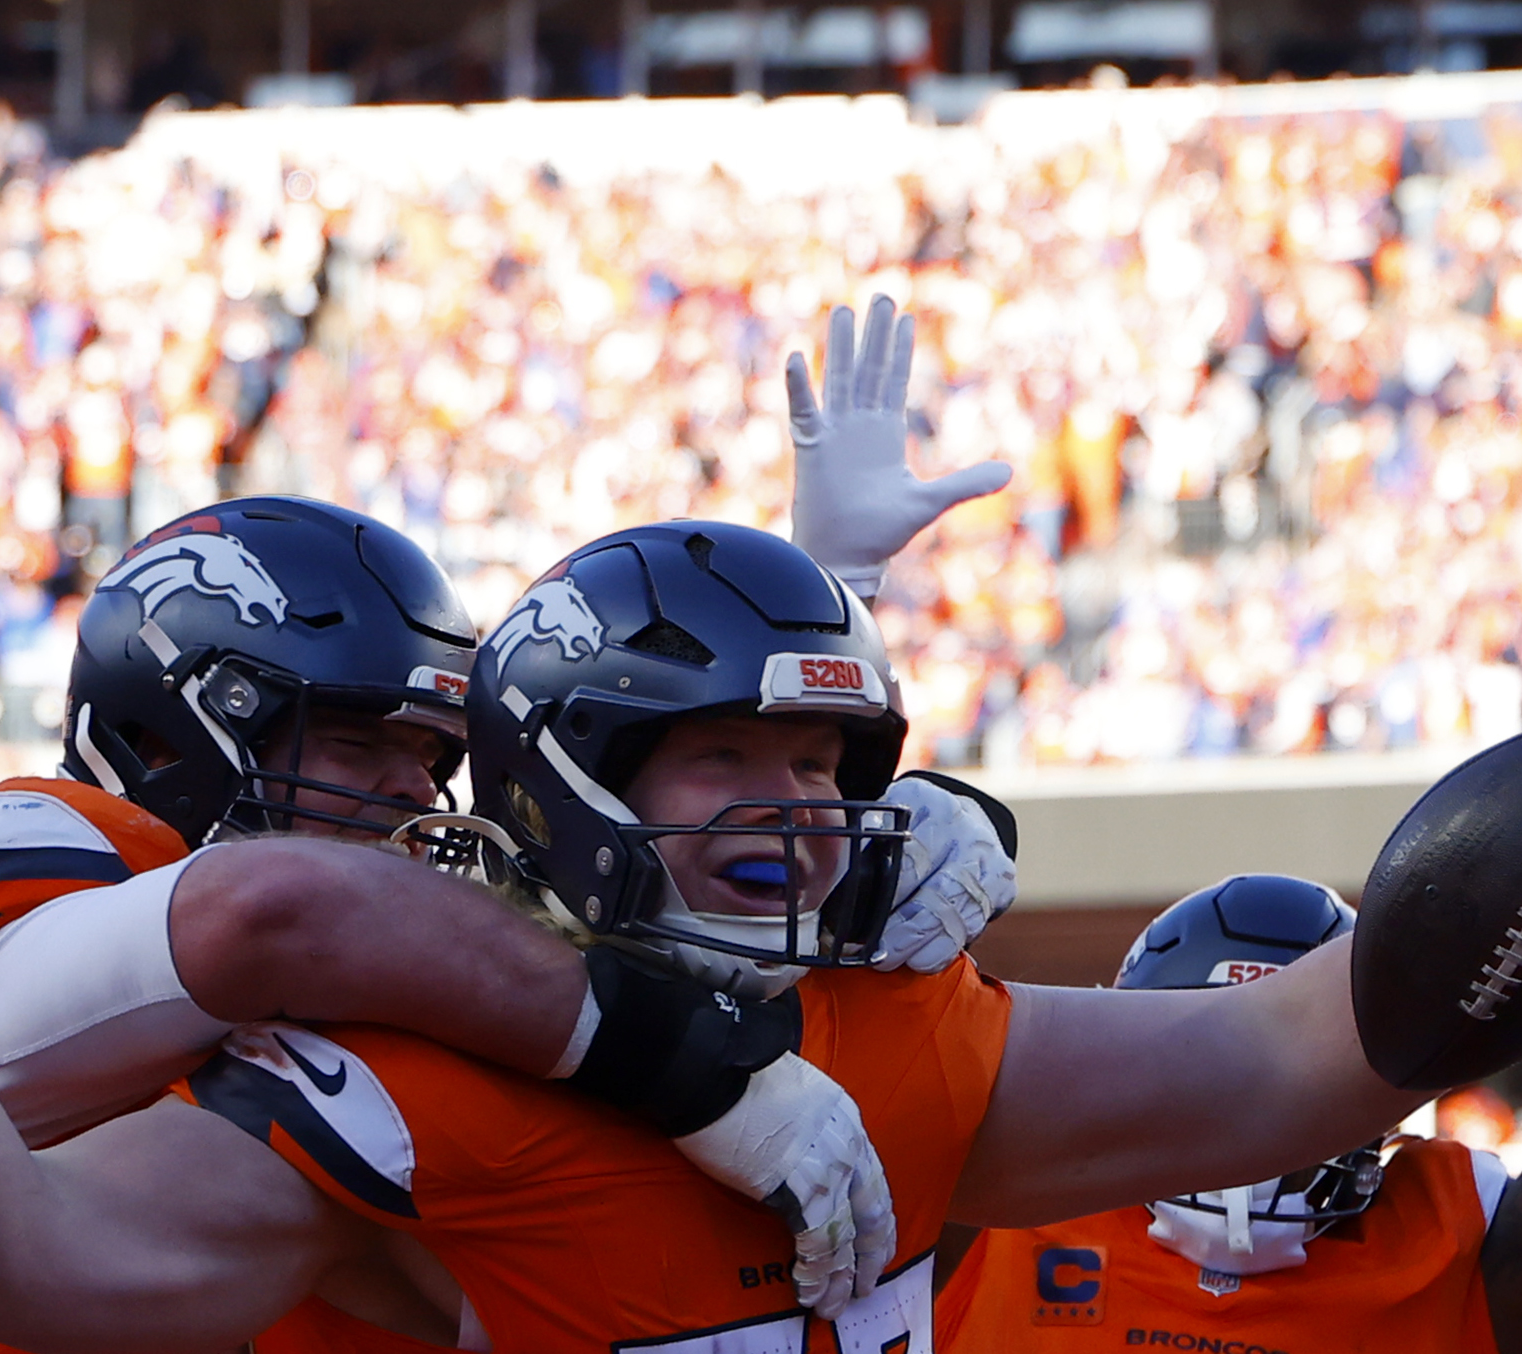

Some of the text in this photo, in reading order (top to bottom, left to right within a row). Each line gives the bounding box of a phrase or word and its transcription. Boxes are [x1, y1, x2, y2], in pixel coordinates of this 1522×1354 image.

[800, 659, 864, 690] 5280
[1227, 963, 1279, 985] 52
[1037, 1248, 1102, 1303] C
